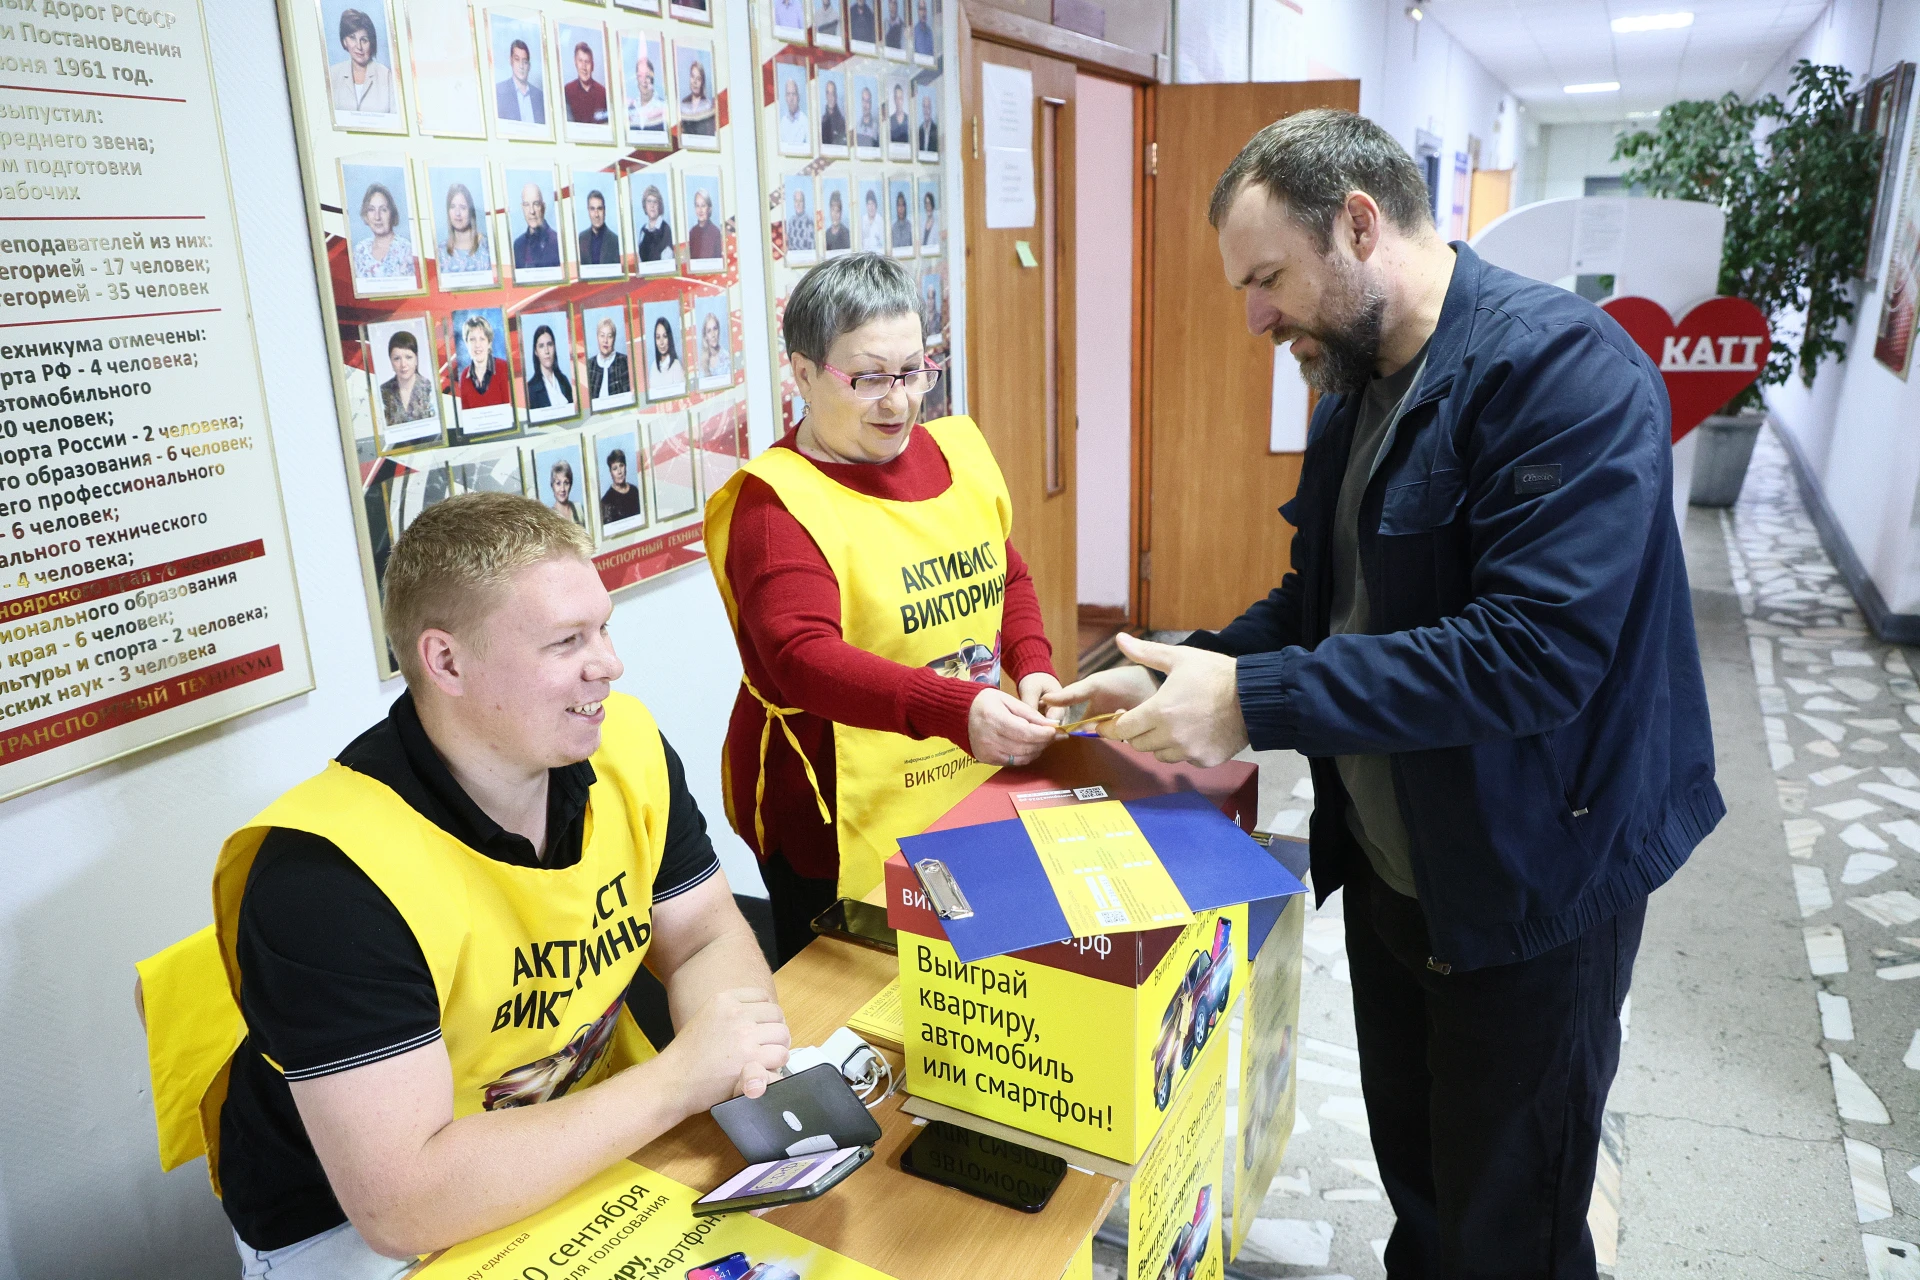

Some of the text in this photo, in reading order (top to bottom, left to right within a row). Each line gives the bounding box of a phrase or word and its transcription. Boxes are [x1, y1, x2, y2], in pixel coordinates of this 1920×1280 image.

[43, 0, 105, 21] дорог
[112, 5, 176, 29] РСФСР
[20, 22, 181, 58] Постановления
[53, 56, 106, 79] 1961
[112, 65, 154, 87] год.
[0, 131, 155, 155] реднего звена;
[25, 159, 142, 178] подготовки
[0, 180, 80, 200] абочих
[0, 232, 213, 256] еподавателей из них:
[0, 258, 85, 283] егорией
[103, 258, 124, 276] 17
[130, 257, 211, 275] человек;
[0, 283, 90, 309] егорией
[107, 282, 130, 300] 35
[135, 281, 209, 299] человек
[0, 328, 207, 360] ехникума отмечены:
[1660, 336, 1763, 372] КАТТ
[0, 369, 36, 391] рта
[41, 362, 72, 382] РФ
[90, 358, 103, 377] 4
[107, 351, 199, 375] человека;
[23, 410, 115, 435] человек;
[57, 431, 127, 456] России
[144, 425, 155, 442] 2
[158, 414, 244, 440] человека;
[26, 451, 152, 487] образования
[167, 445, 178, 462] 6
[181, 435, 253, 459] человек;
[38, 463, 225, 512] профессионального
[12, 521, 25, 540] 6
[30, 506, 120, 535] человек;
[85, 511, 208, 550] технического
[17, 571, 30, 588] 4
[34, 551, 135, 584] человека;
[166, 562, 177, 577] 6
[594, 527, 703, 572] АНСПОРТНЫЙ ТЕХНИК
[901, 541, 998, 594] АКТИВИСТ
[124, 571, 237, 610] образования
[900, 573, 1005, 634] ВИКТОРИН
[7, 643, 57, 668] края
[75, 631, 87, 648] 6
[91, 610, 174, 643] человек;
[76, 658, 90, 672] и
[94, 637, 157, 667] спорта
[172, 627, 184, 643] 2
[187, 605, 268, 638] человека;
[57, 676, 104, 701] наук
[119, 665, 131, 682] 3
[135, 642, 217, 676] человека
[177, 655, 272, 697] ТЕХНИКУМ
[904, 755, 978, 788] викторин
[917, 944, 1028, 998] Выиграй
[919, 987, 1041, 1043] квартиру,
[921, 1022, 1074, 1084] автомобиль
[923, 1056, 1113, 1132] или смартфон!
[1186, 1074, 1222, 1144] сентября
[549, 1184, 651, 1267] сентября
[588, 1194, 671, 1265] голосования
[1138, 1211, 1169, 1279] Выиграй
[482, 1232, 531, 1272] единства
[639, 1214, 727, 1280] смартфон
